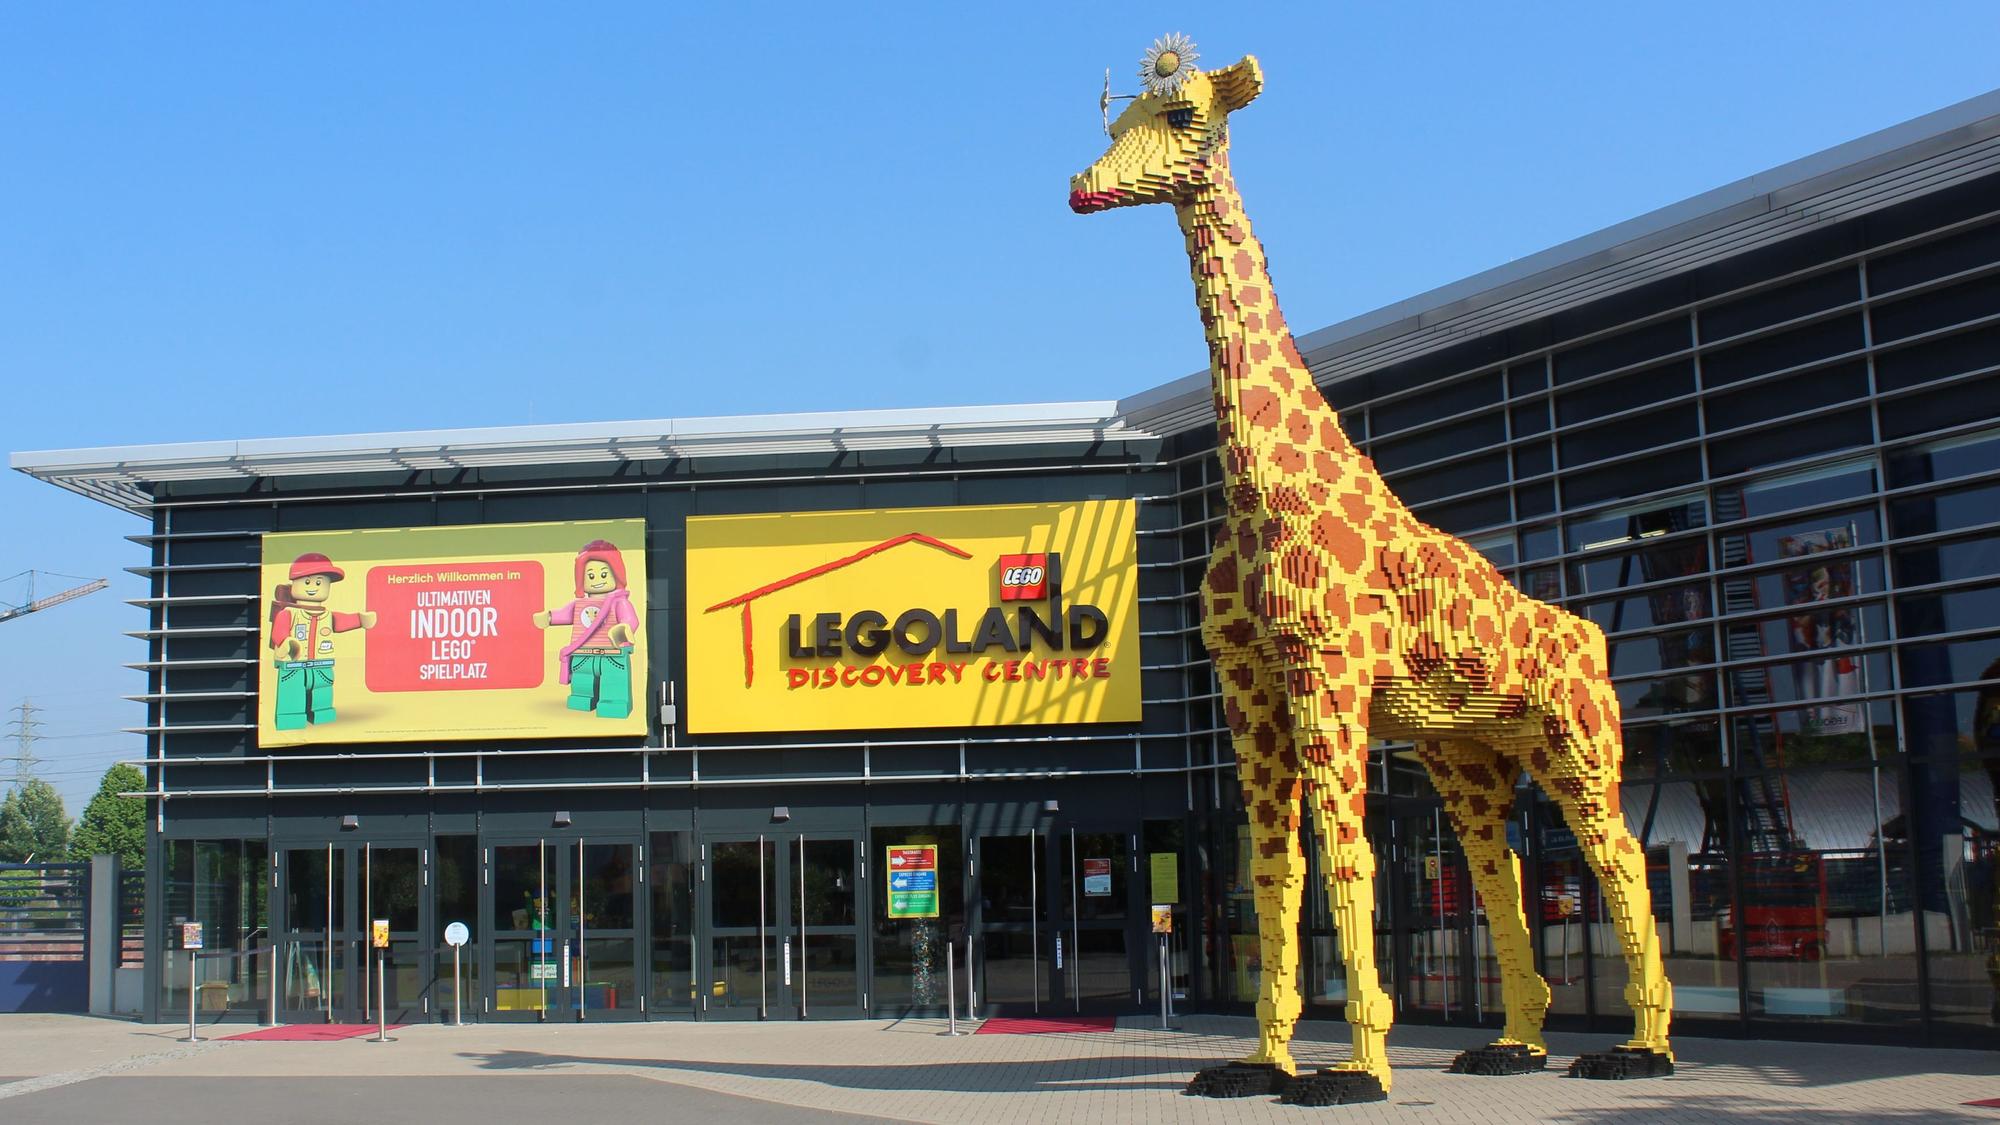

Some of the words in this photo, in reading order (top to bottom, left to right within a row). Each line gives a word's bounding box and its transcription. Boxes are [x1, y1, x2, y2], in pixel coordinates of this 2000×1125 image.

[387, 572, 434, 584] Herzlich
[436, 571, 504, 583] Willkommen
[507, 570, 521, 580] im
[1004, 567, 1042, 586] LEGO
[417, 589, 491, 607] ULTIMATIVEN
[410, 606, 498, 639] INDOOR
[419, 662, 488, 680] SPIELPLATZ
[787, 660, 968, 690] DISCOVERY
[983, 656, 1111, 683] CENTRE
